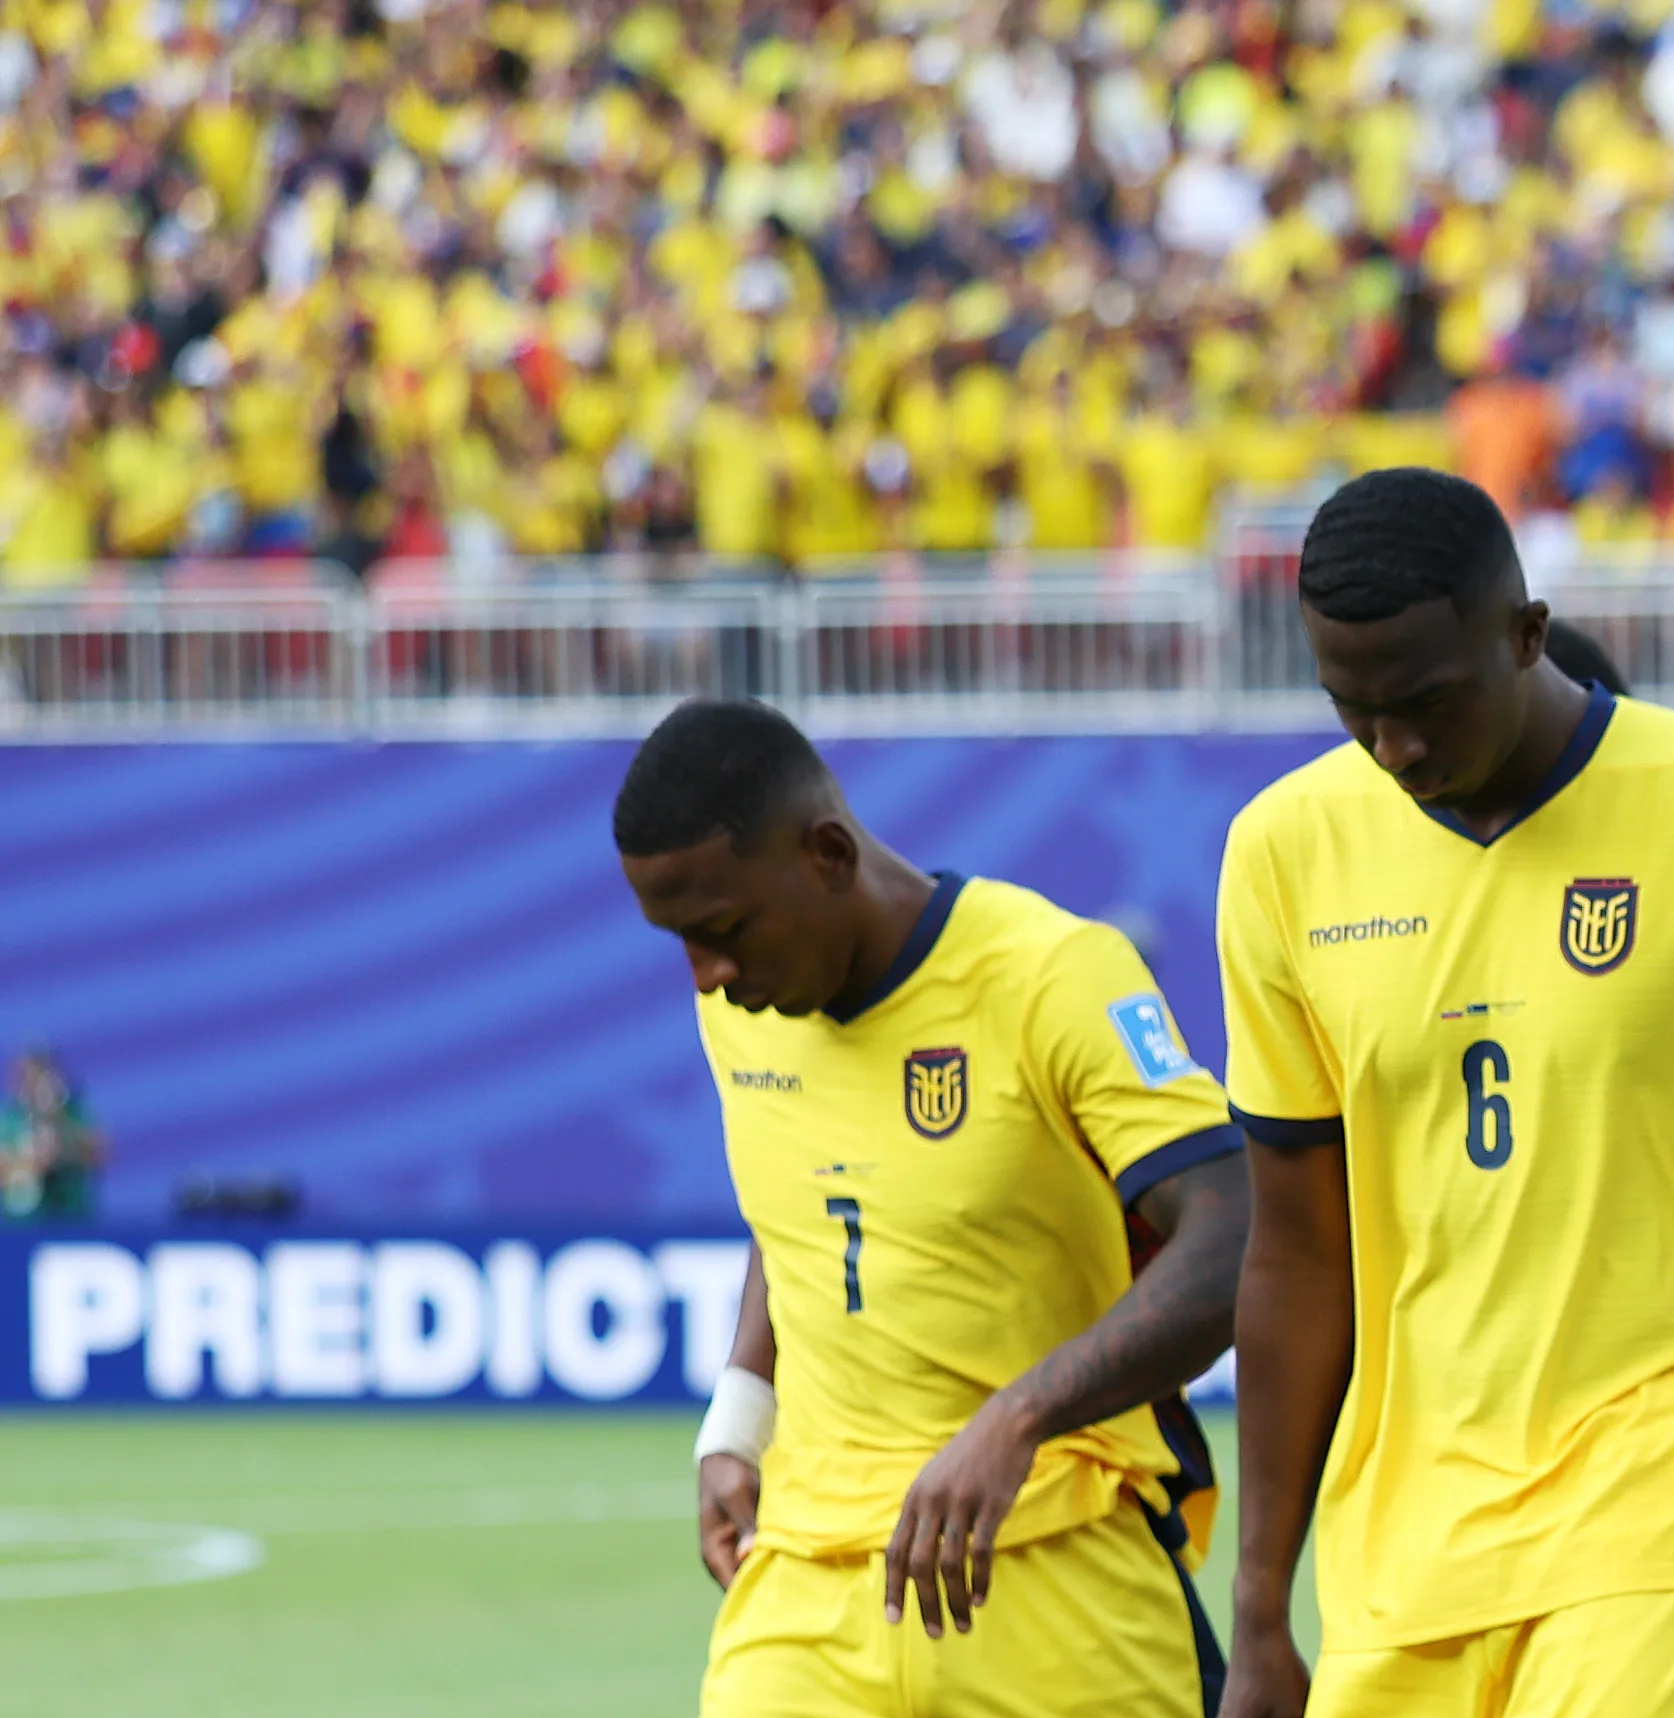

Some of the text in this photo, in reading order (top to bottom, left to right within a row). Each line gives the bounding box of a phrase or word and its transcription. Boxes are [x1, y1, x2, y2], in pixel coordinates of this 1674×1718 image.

[1308, 914, 1429, 949] marathon
[1462, 1038, 1514, 1171] 6
[826, 1197, 863, 1315] 7
[29, 1240, 750, 1400] PREDICT
